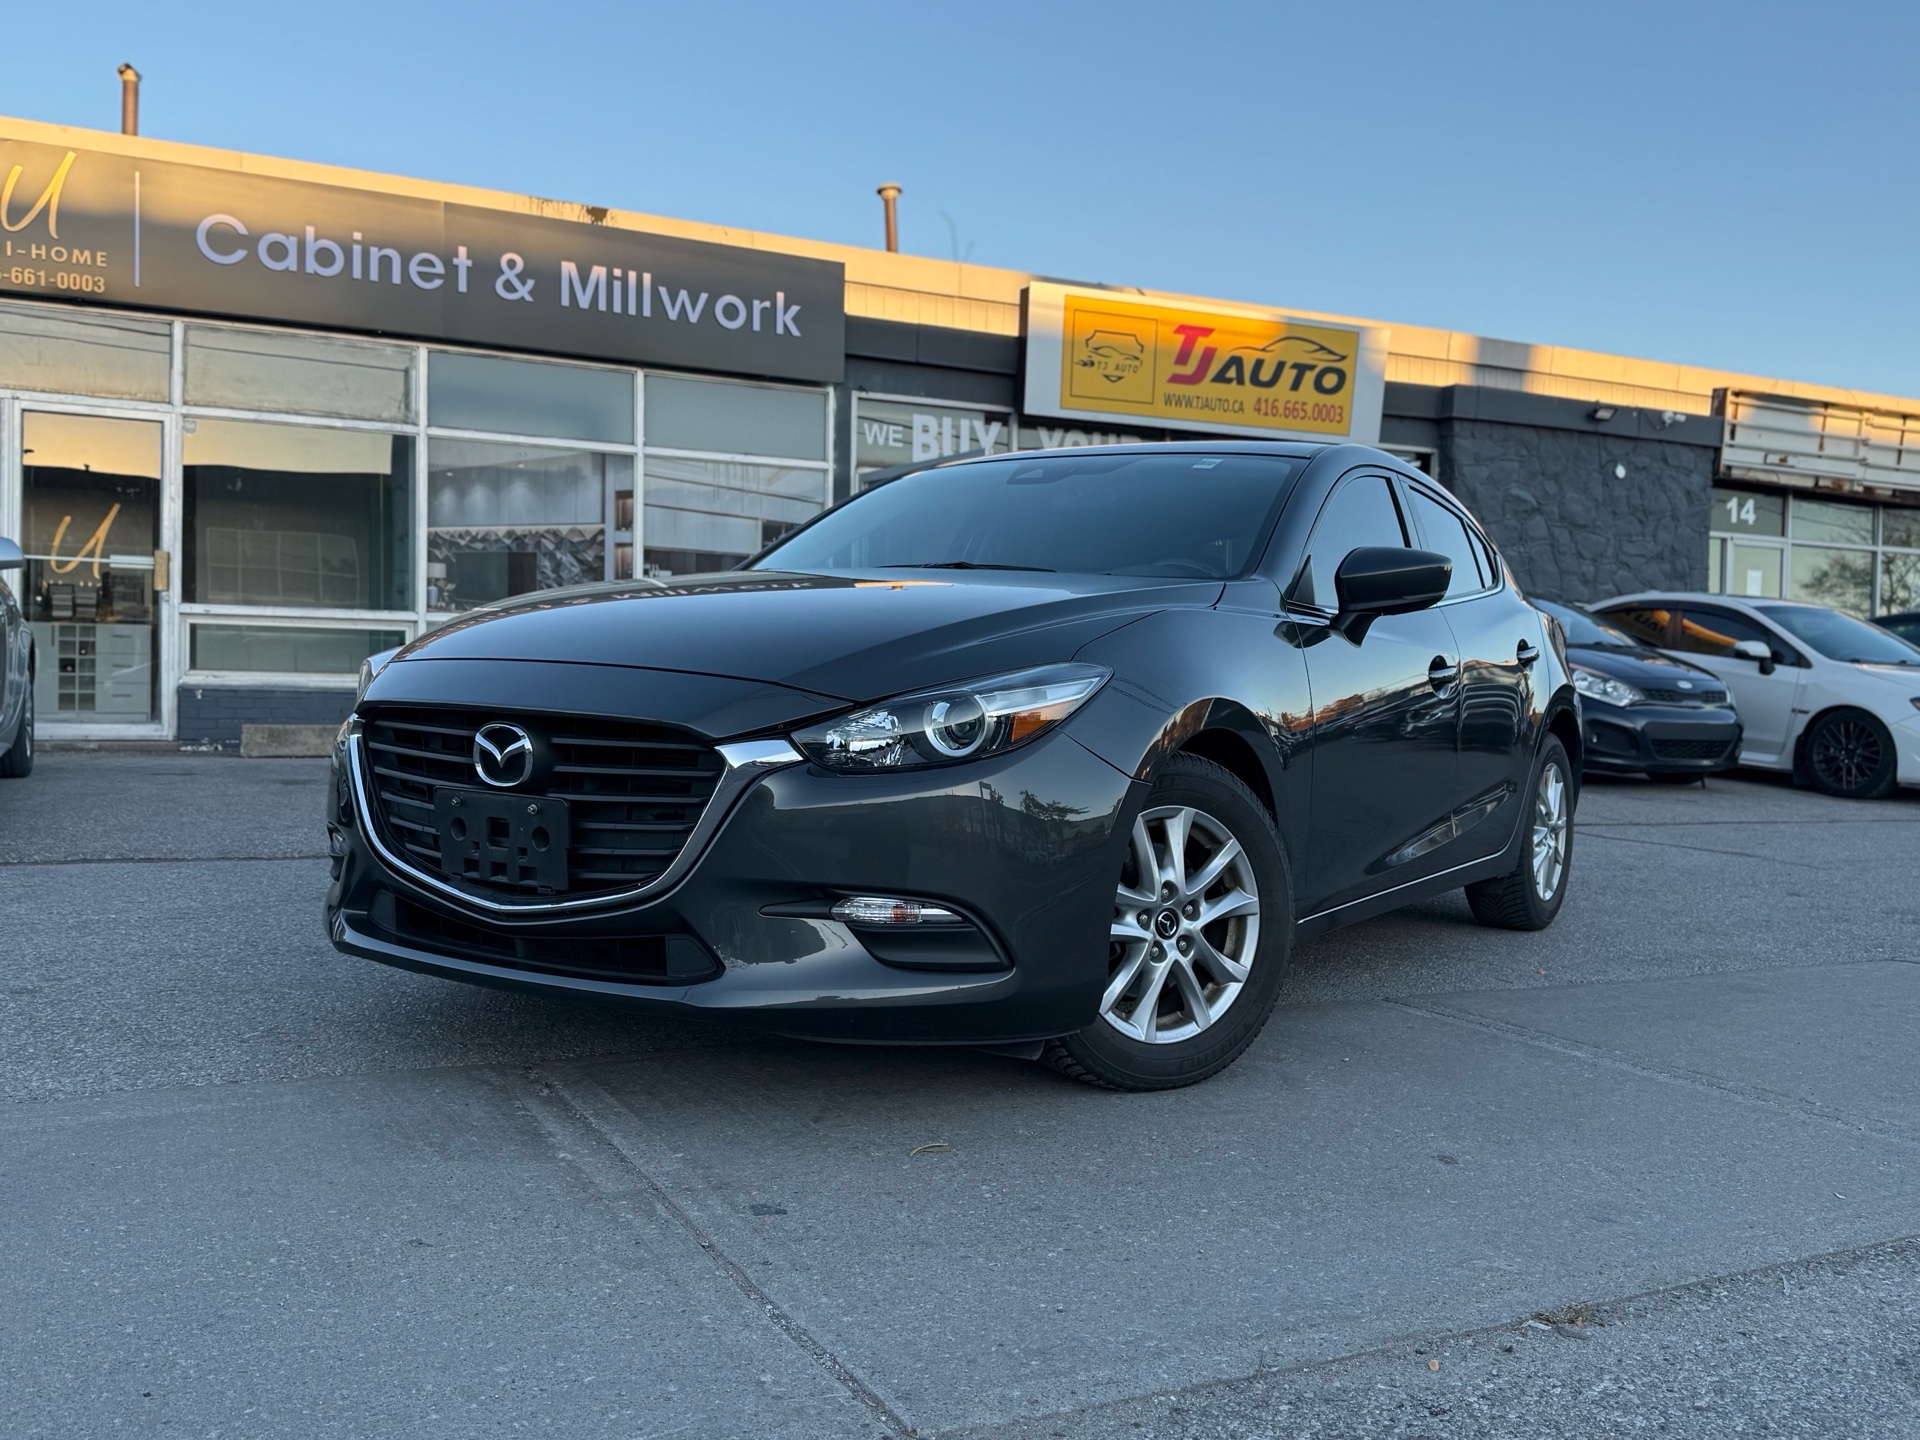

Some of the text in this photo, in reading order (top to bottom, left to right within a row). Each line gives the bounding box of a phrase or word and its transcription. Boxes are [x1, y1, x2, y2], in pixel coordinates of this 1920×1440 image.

[0, 266, 105, 294] -661-0003
[196, 213, 802, 337] Cabinet & Millwork
[1164, 392, 1344, 423] WWW.TJAUTO.CA 416.665.0003
[864, 422, 904, 448] WE
[912, 413, 1002, 462] BUY
[1726, 496, 1756, 525] 14
